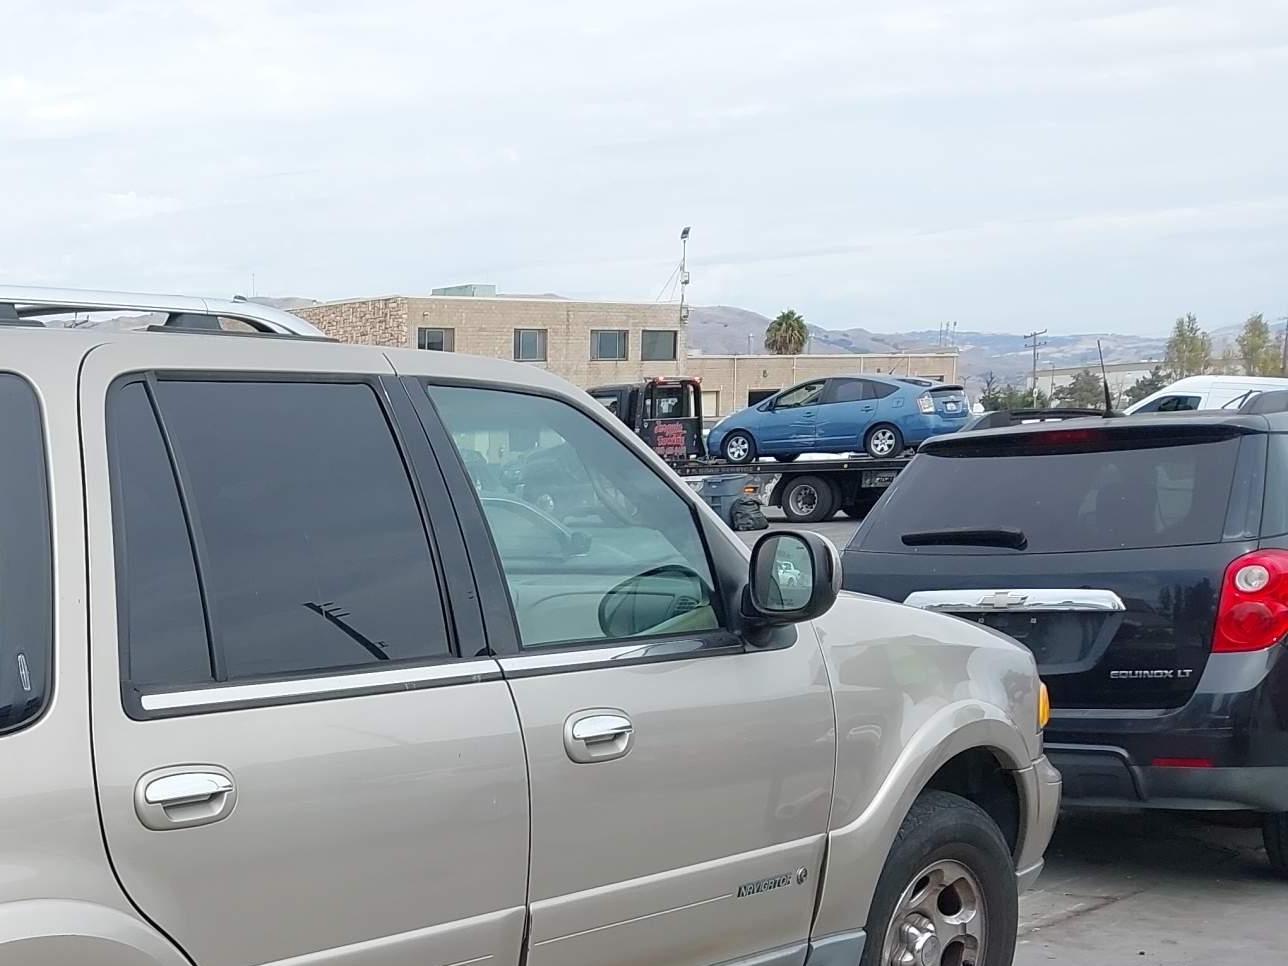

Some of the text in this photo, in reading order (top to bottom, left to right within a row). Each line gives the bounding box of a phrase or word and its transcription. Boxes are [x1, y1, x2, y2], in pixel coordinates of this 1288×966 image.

[1110, 669, 1193, 679] EQUINOX LT
[737, 874, 792, 898] NAVIGATOR
